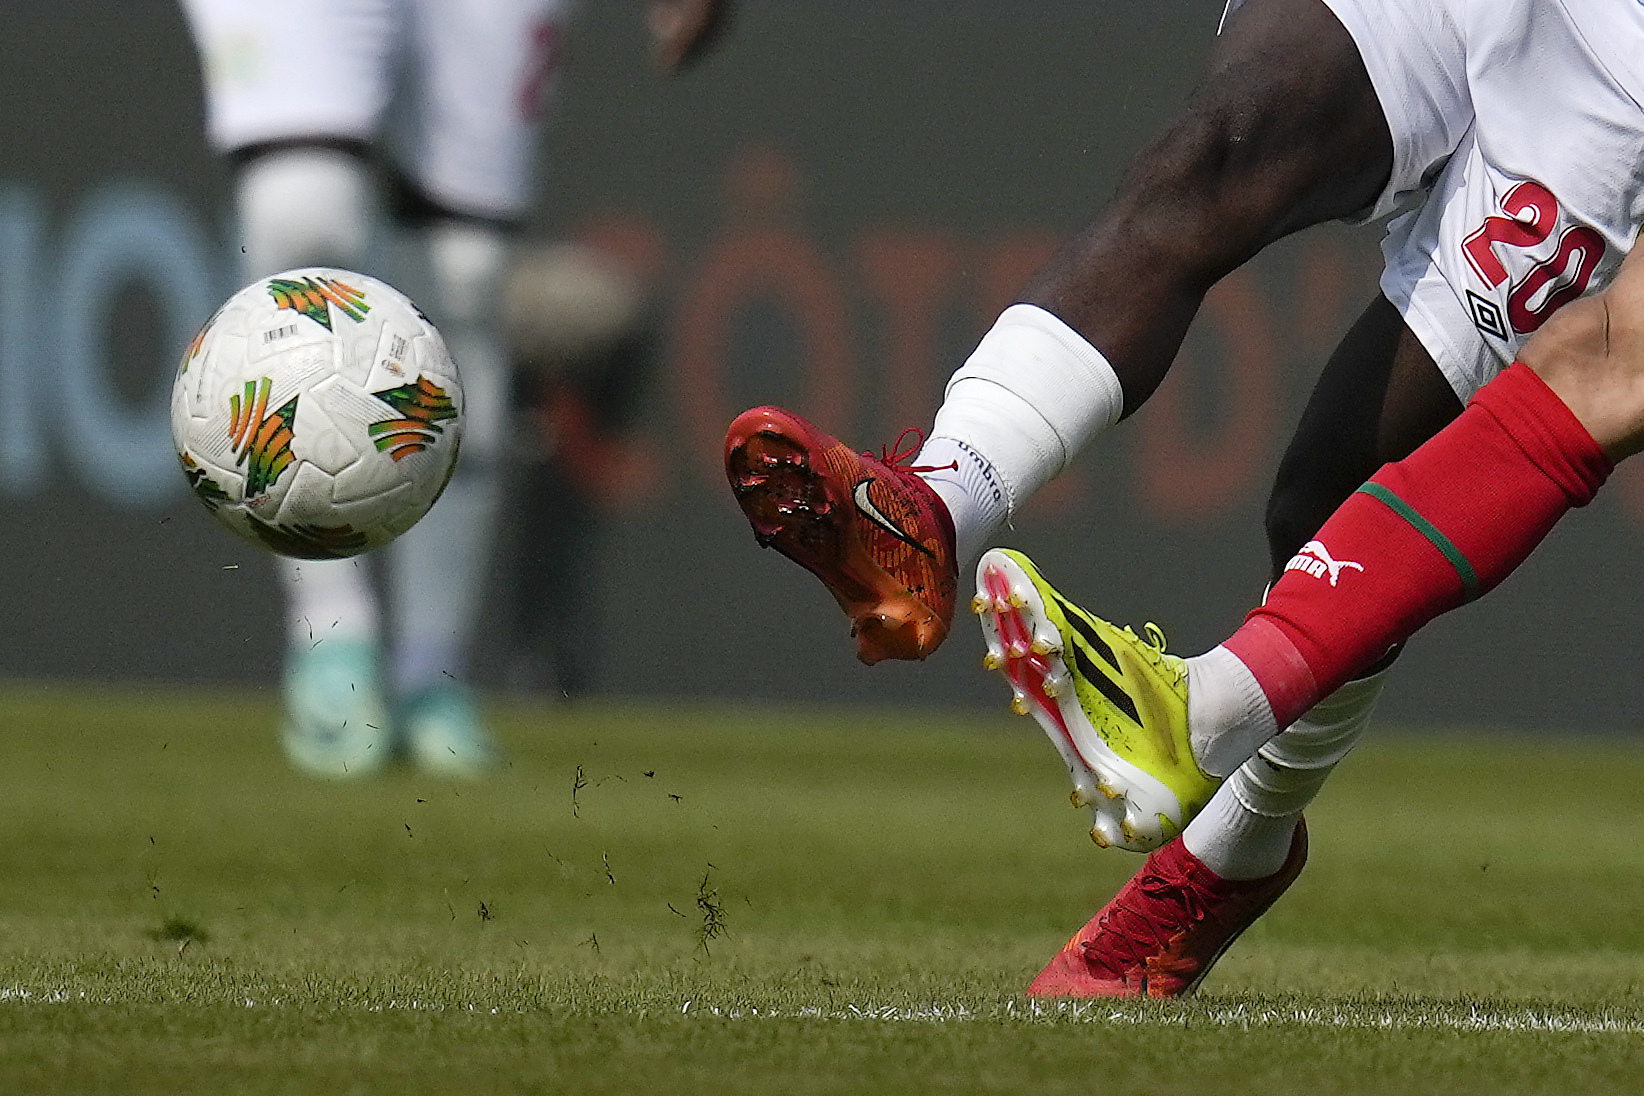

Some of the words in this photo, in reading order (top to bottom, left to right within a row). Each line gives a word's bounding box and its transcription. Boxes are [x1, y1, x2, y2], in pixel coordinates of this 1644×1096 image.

[1461, 181, 1606, 335] 20
[957, 440, 1001, 503] umbro
[1284, 554, 1328, 580] MA
